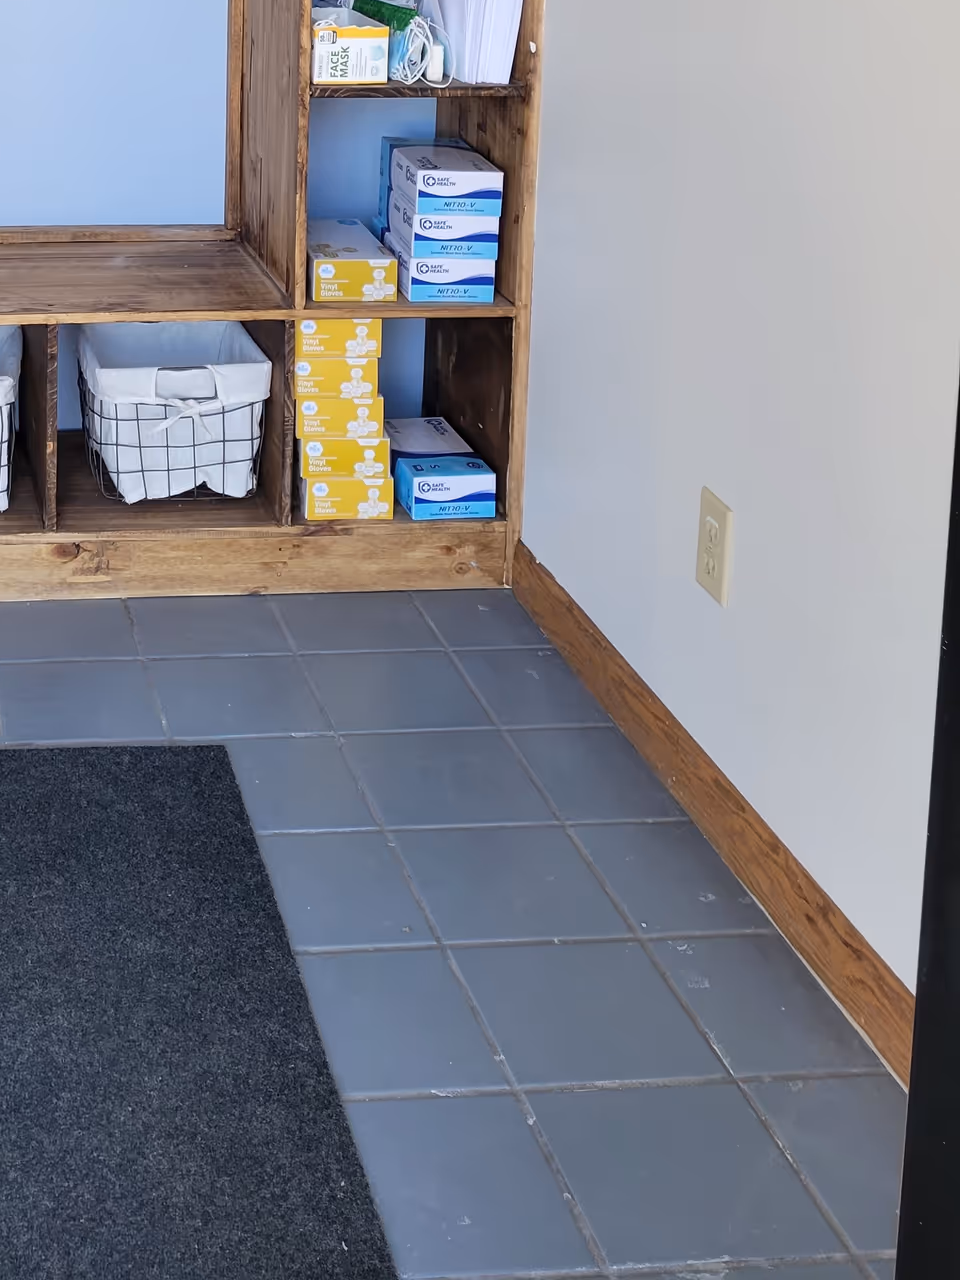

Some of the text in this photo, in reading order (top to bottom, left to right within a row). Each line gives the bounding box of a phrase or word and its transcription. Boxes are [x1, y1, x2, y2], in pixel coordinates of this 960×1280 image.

[330, 50, 340, 78] FACE
[339, 46, 350, 78] MASK
[321, 283, 338, 291] Vinyl
[308, 458, 326, 466] Vinyl
